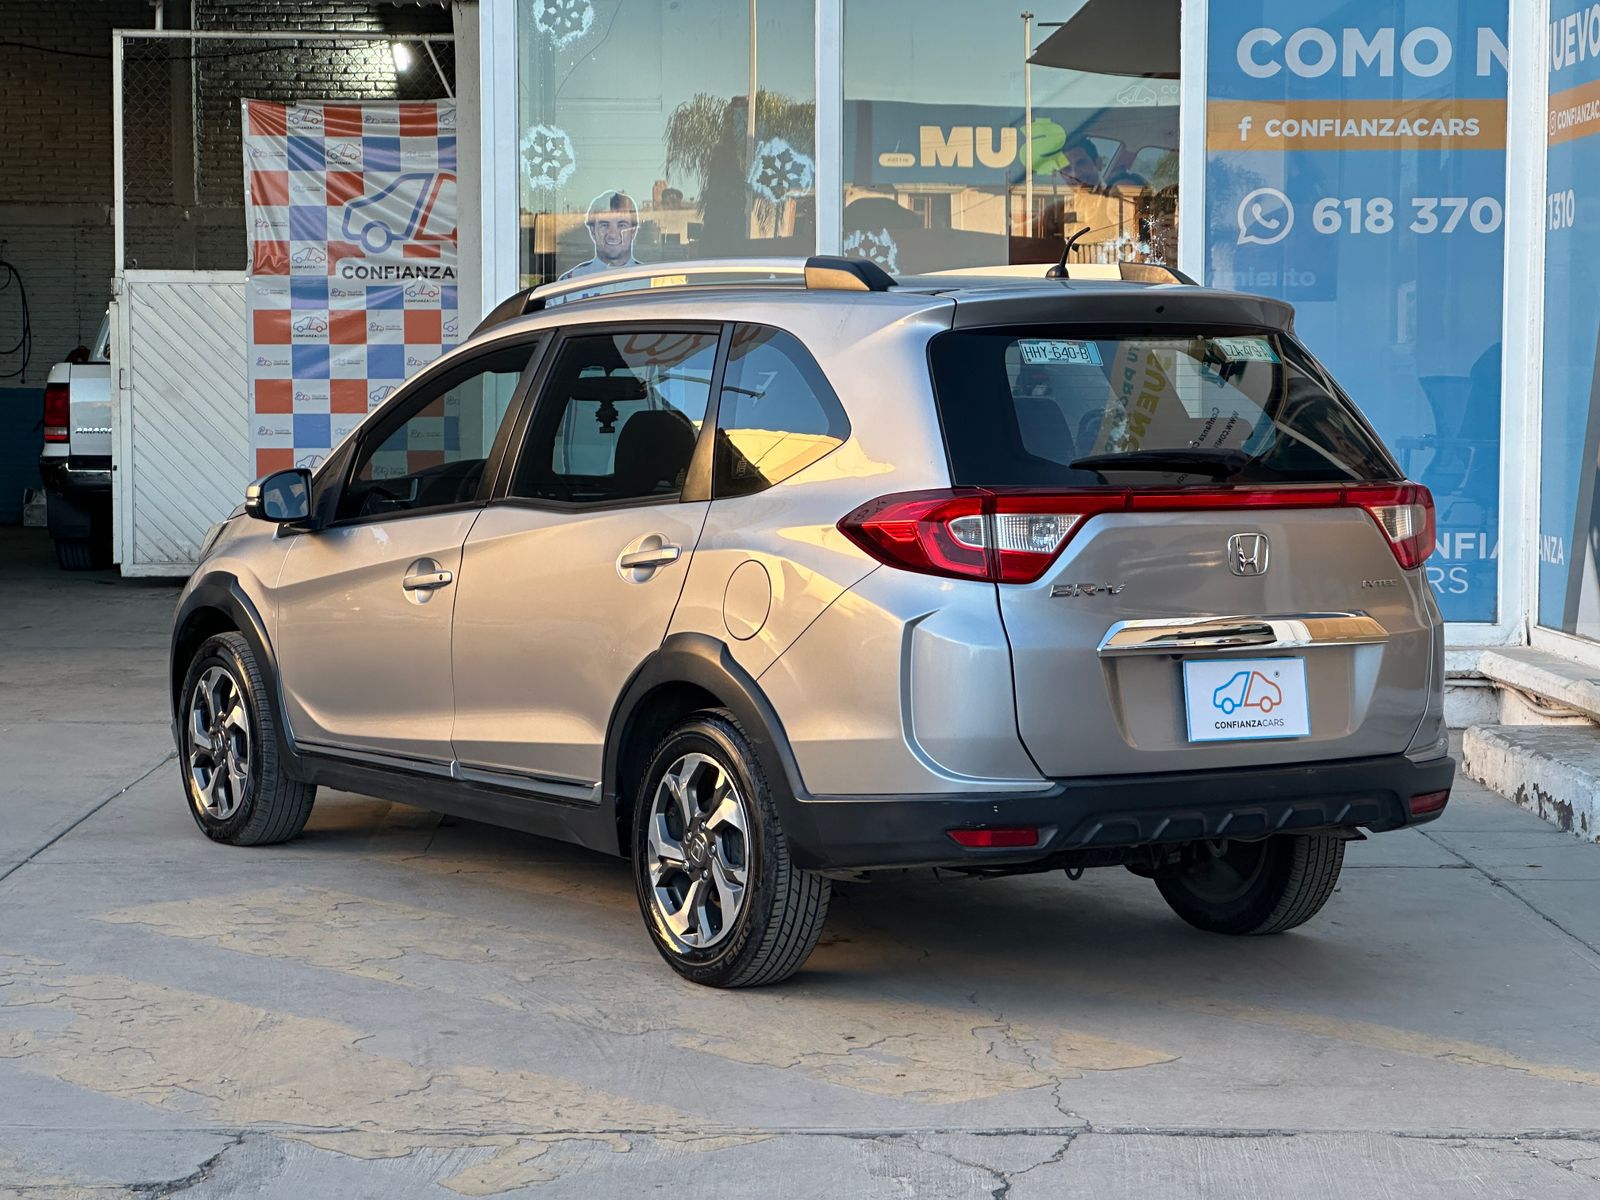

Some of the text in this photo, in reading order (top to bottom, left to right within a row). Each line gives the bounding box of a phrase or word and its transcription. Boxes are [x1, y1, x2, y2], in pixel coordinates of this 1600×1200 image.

[1549, 3, 1600, 73] UEVO
[1236, 27, 1453, 79] COMO
[1557, 101, 1600, 130] CONFIANZAC
[1264, 117, 1480, 138] CONFIANZACARS
[1312, 196, 1503, 235] 618 370
[341, 265, 457, 280] CONFIANZA
[1024, 346, 1089, 360] HHY-640-B
[1049, 580, 1127, 598] BR-V
[1214, 718, 1285, 730] CONFIANZACARS
